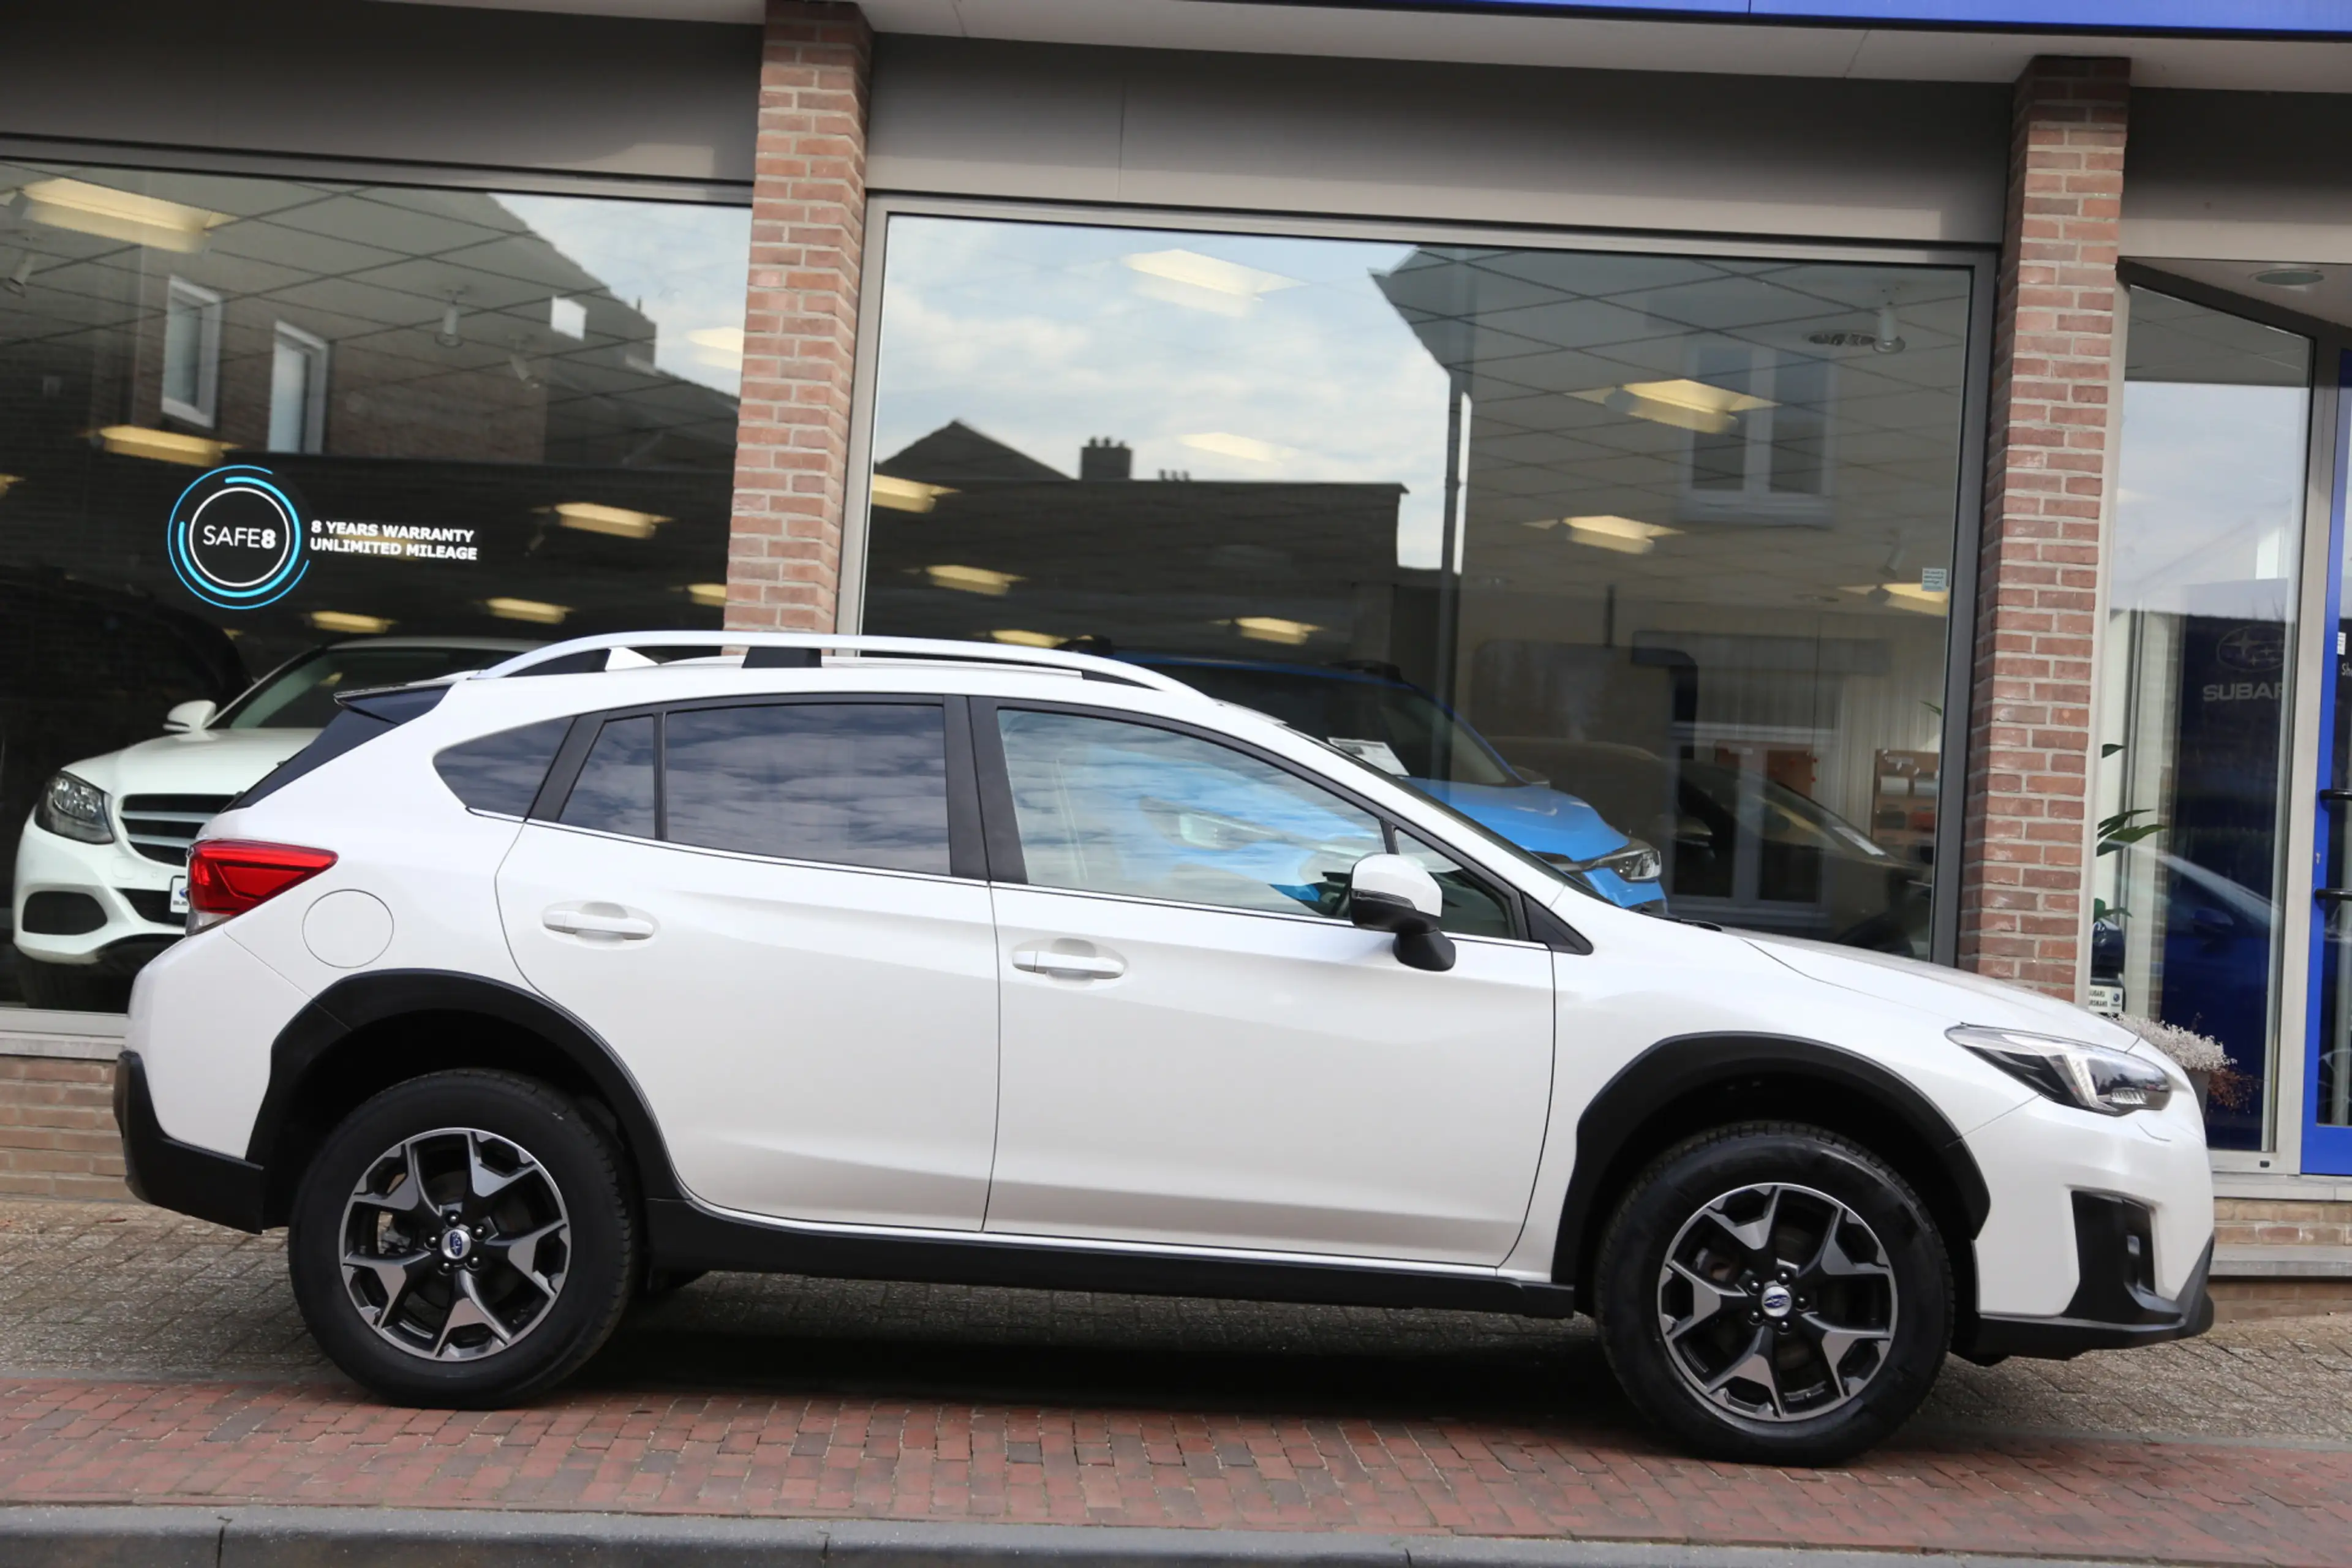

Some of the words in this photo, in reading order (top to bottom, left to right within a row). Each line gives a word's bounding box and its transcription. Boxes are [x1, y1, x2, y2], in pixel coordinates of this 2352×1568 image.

[203, 524, 276, 549] SAFE8
[311, 520, 322, 533] 8
[326, 521, 379, 537] YEARS
[382, 525, 475, 543] WARRANTY
[310, 537, 402, 556] UNLIMITED
[406, 543, 477, 560] MILEAGE
